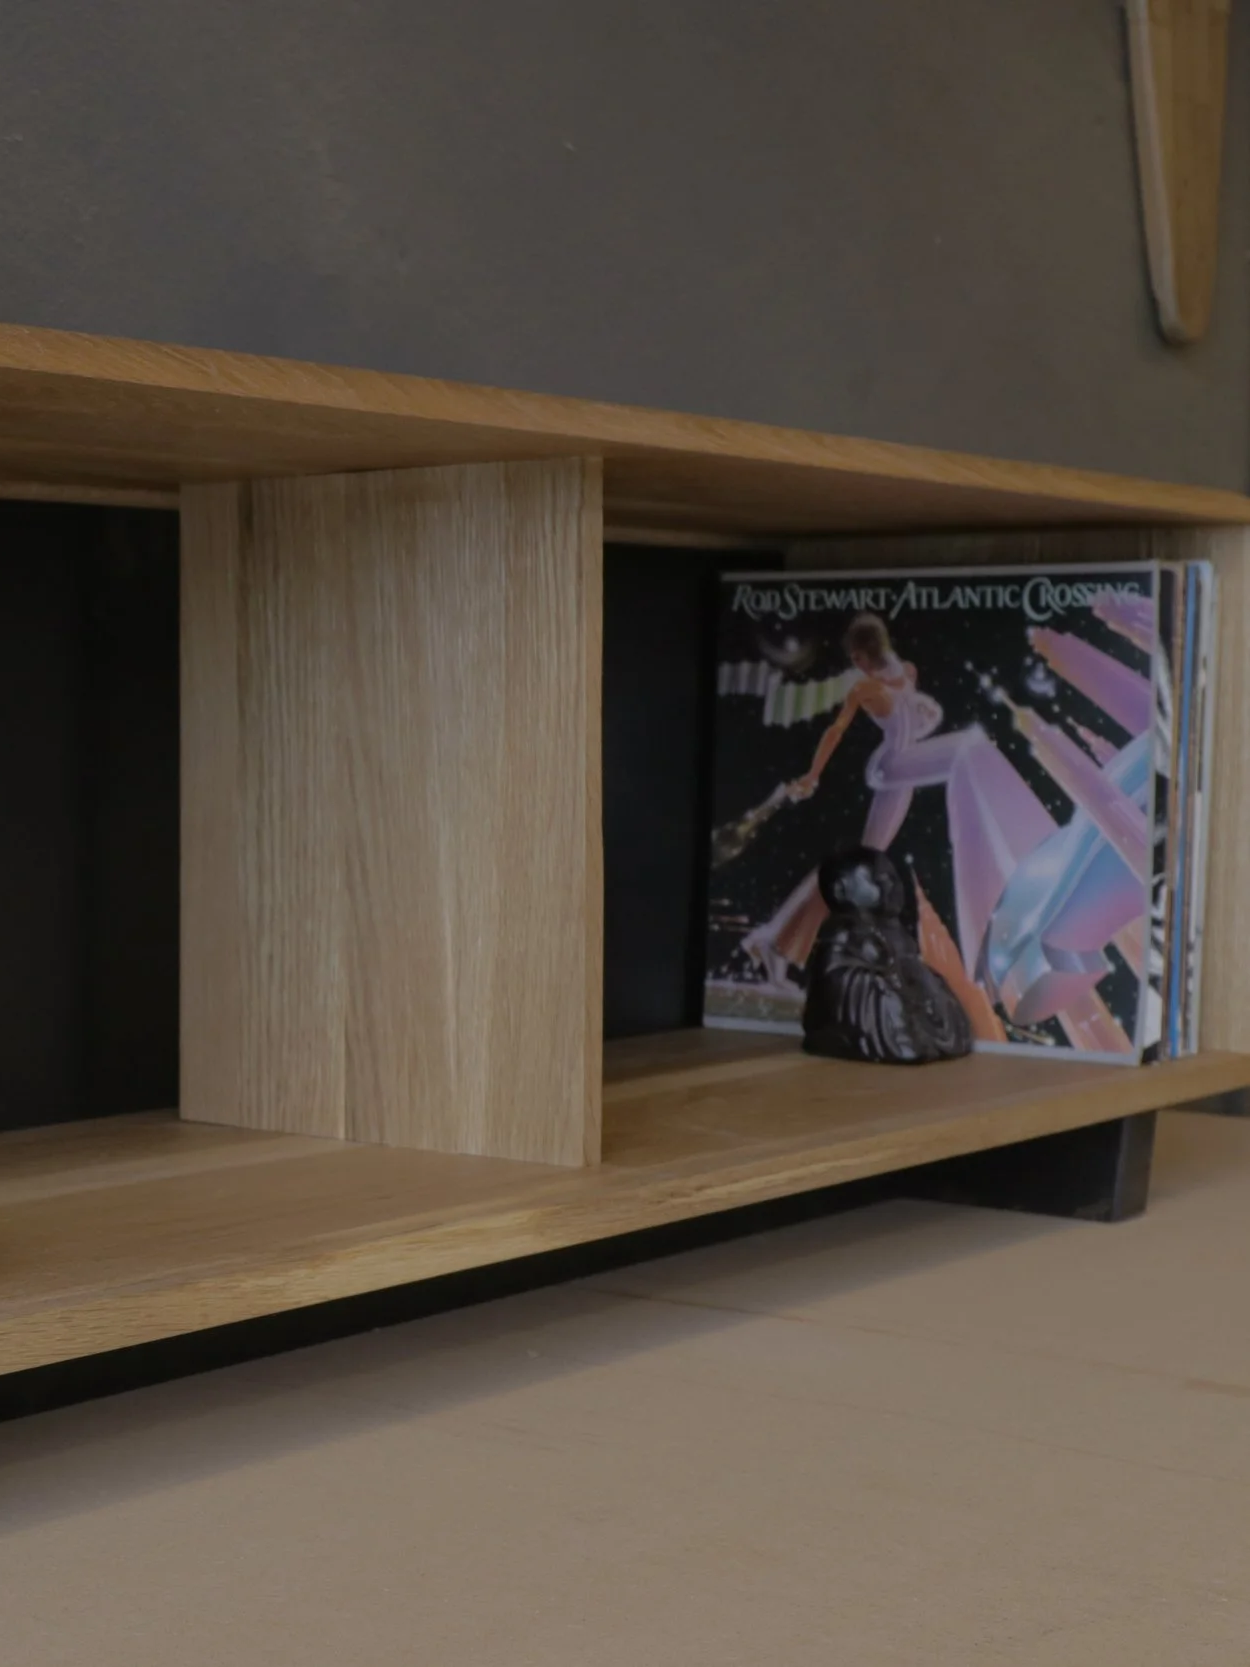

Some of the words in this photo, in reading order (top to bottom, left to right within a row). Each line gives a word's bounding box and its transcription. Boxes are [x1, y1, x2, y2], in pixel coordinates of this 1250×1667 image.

[731, 582, 781, 621] ROD
[778, 582, 891, 620] STEWART
[889, 579, 1021, 620] ATLANTIC
[1022, 576, 1141, 621] CROSSING
